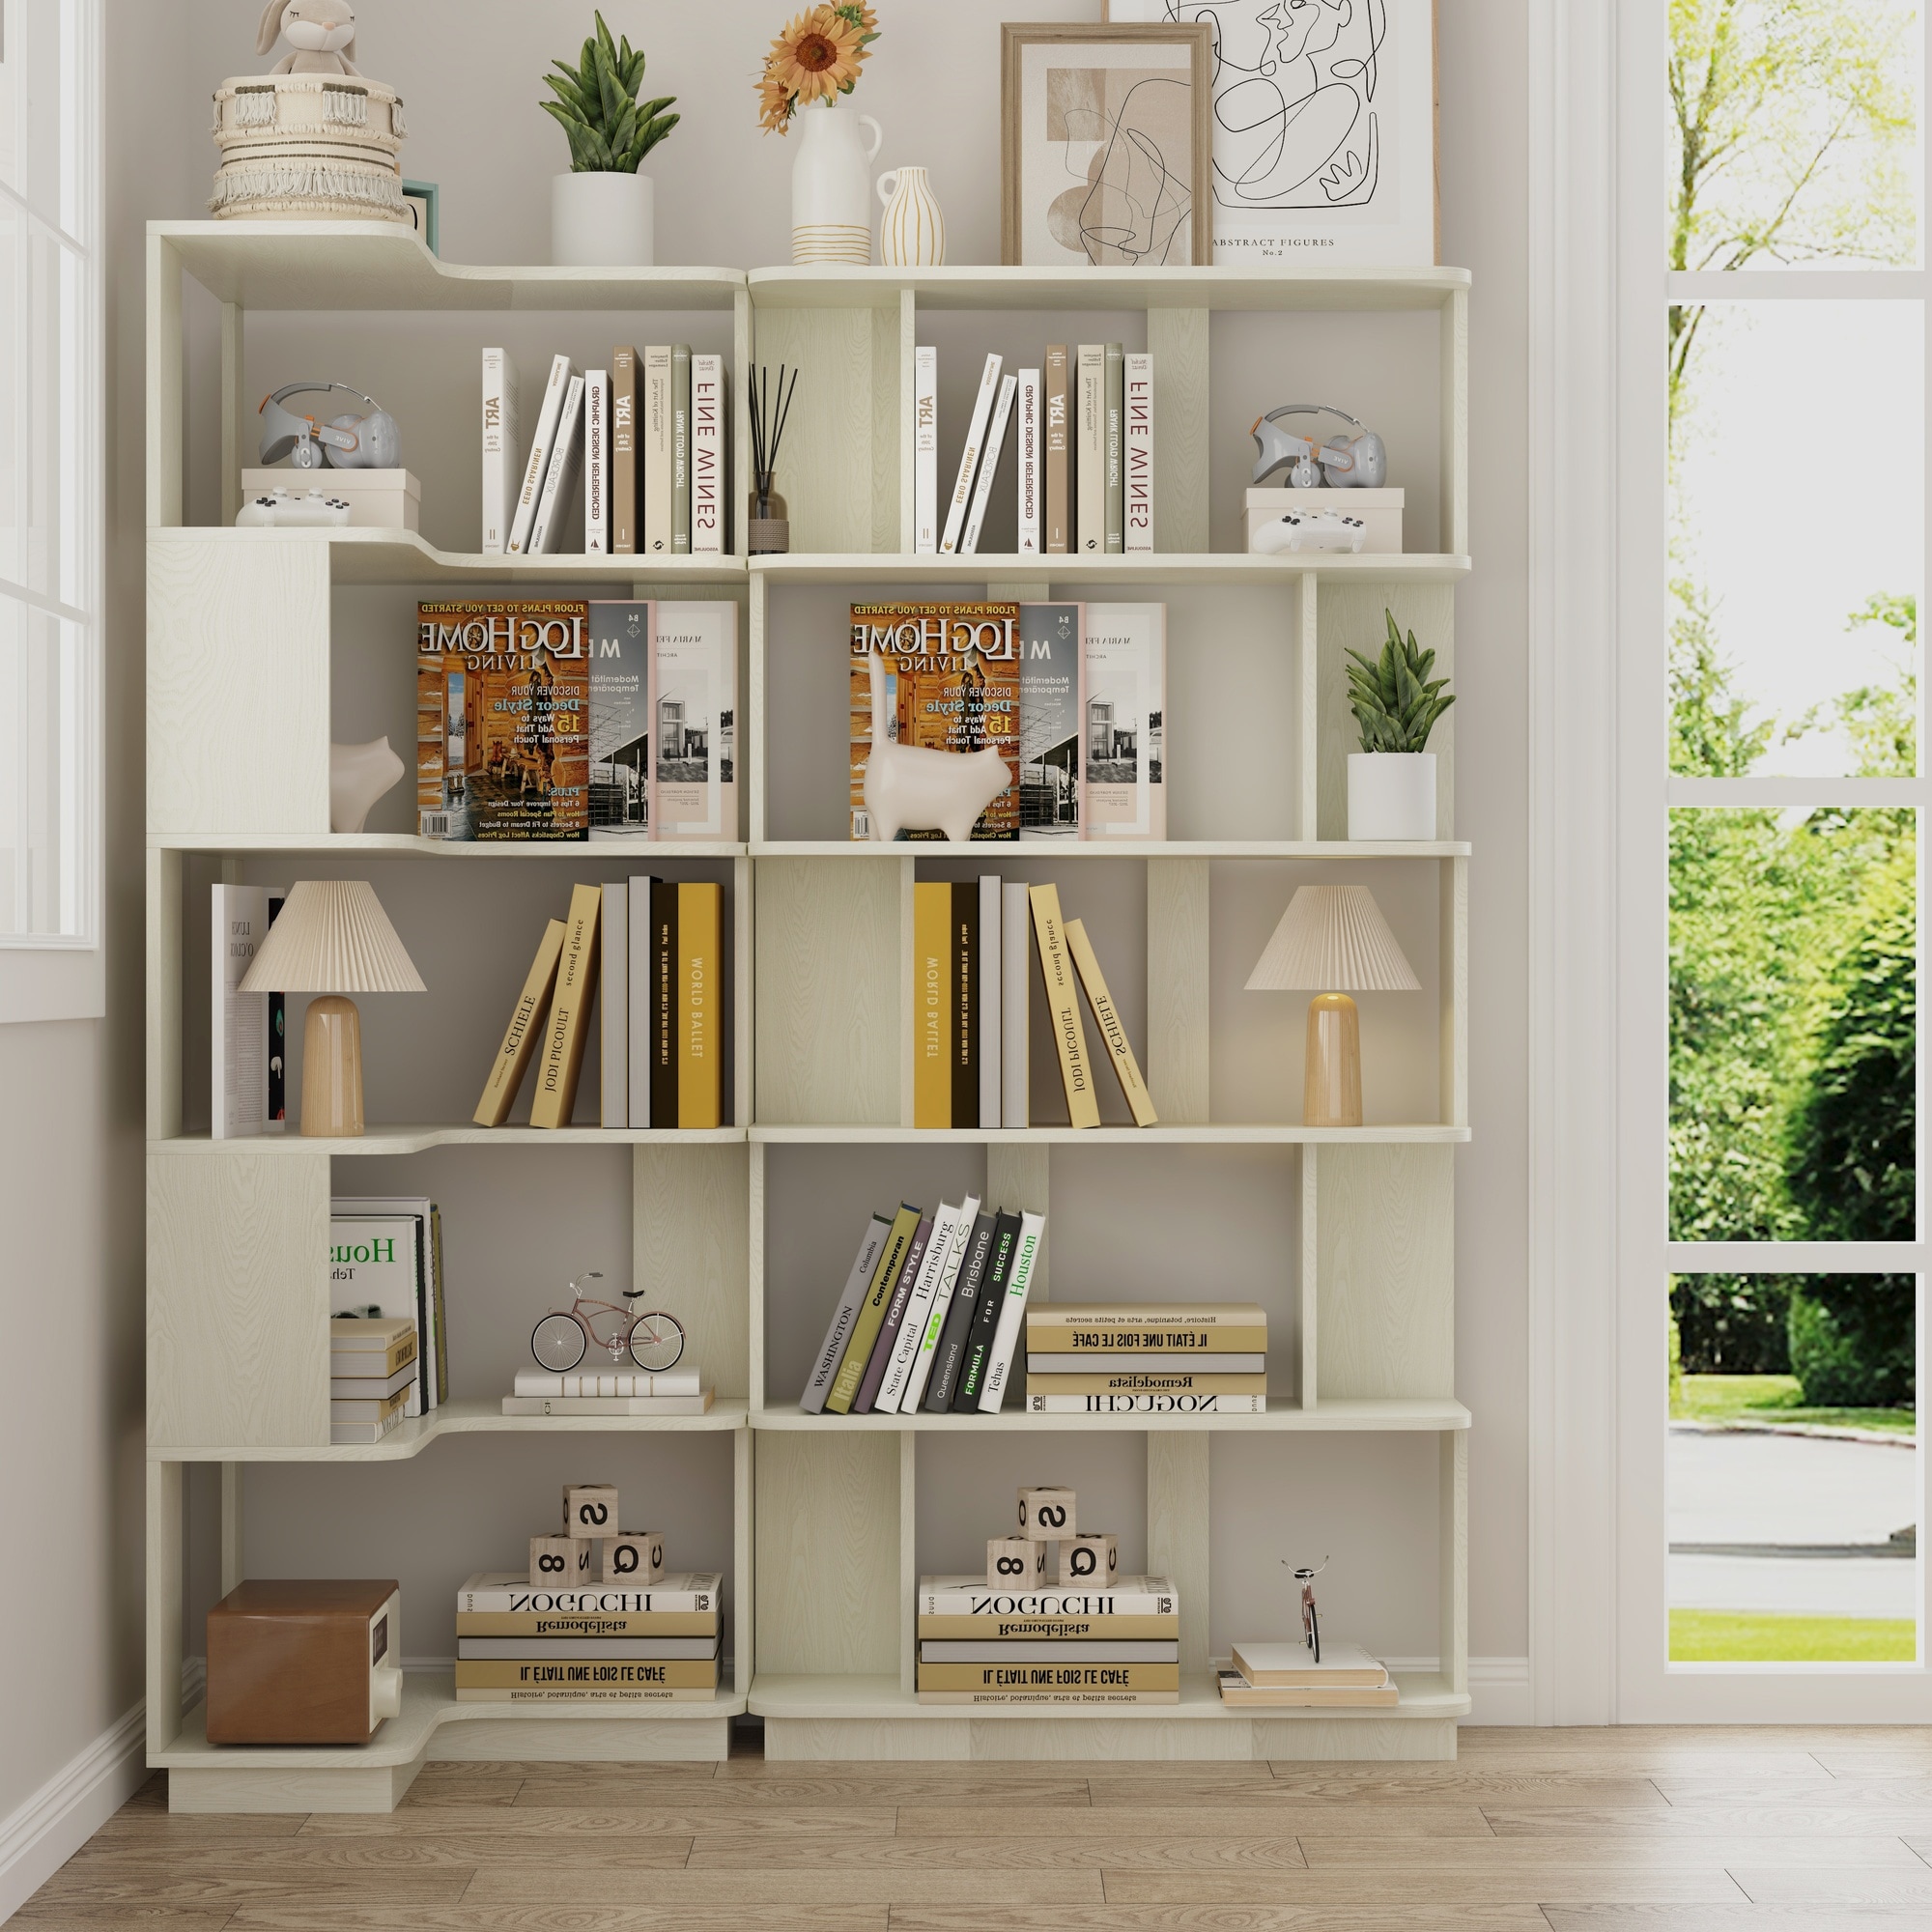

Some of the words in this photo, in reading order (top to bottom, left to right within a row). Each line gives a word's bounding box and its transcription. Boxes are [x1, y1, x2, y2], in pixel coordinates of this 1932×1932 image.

[566, 952, 578, 986] second
[573, 919, 583, 951] glance
[691, 957, 703, 1006] WORLD
[504, 995, 536, 1056] SCHIELE
[544, 1065, 559, 1093] JODI
[551, 1007, 570, 1062] PICOULT
[691, 1011, 703, 1058] BALLET
[814, 1306, 853, 1387] WASHINGTON
[859, 1240, 877, 1273] Columbia
[834, 1359, 863, 1402] Italia
[872, 1236, 904, 1307] Contemporan
[887, 1368, 904, 1397] State
[897, 1323, 918, 1364] Capital
[916, 1221, 954, 1300] Harrisburg
[888, 1288, 907, 1327] FORM
[903, 1240, 923, 1284] STYLE
[923, 1313, 942, 1352] TED
[937, 1223, 970, 1301] TALKS
[937, 1344, 958, 1399] Queensland
[961, 1231, 989, 1298] Brisbane
[965, 1344, 984, 1396] FORMULA
[983, 1300, 995, 1323] FOR
[992, 1233, 1011, 1282] SUCCESS
[988, 1361, 1005, 1393] Tehas
[1009, 1235, 1037, 1297] Houston
